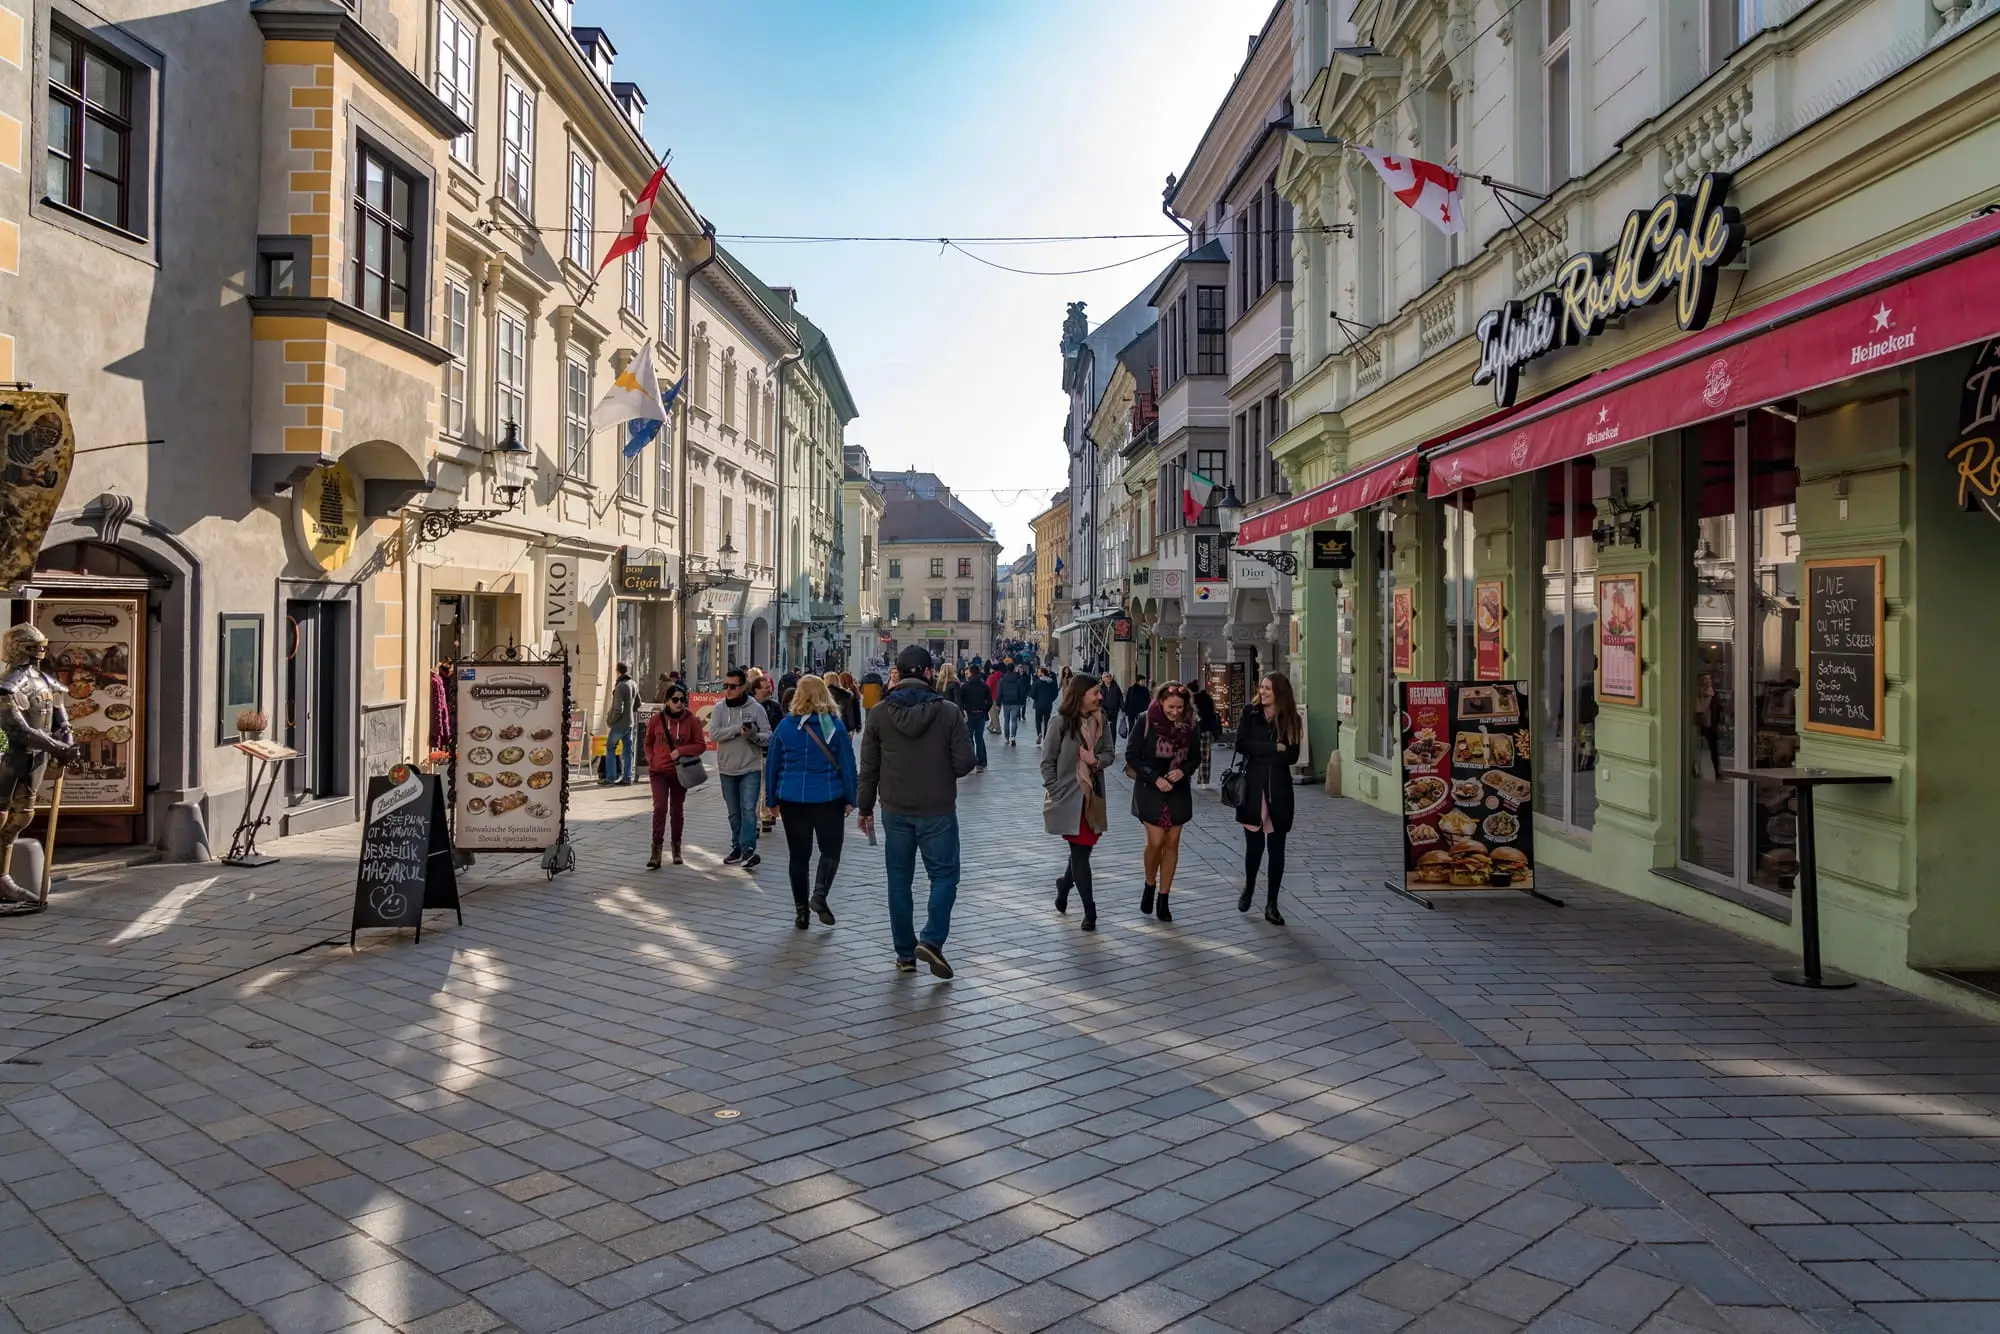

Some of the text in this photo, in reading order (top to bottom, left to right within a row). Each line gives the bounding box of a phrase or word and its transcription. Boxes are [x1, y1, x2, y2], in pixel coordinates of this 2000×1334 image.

[1473, 292, 1556, 408] Infiniti
[1850, 333, 1914, 365] Heineken
[1586, 427, 1618, 446] Heineken
[1241, 567, 1265, 577] Dior
[624, 576, 659, 591] Cigár
[1816, 576, 1845, 595] LIVE
[548, 562, 567, 625] IVKO
[1825, 599, 1857, 615] SPORT
[1816, 618, 1851, 632] ON THE
[1823, 634, 1875, 648] BIG SCREEN
[1818, 660, 1857, 682] Saturday
[1409, 687, 1446, 698] RESTAURANT
[1818, 703, 1870, 720] on the BAR
[465, 825, 552, 835] Slowakische Spezialitäten
[361, 860, 425, 883] MAGYARUL
